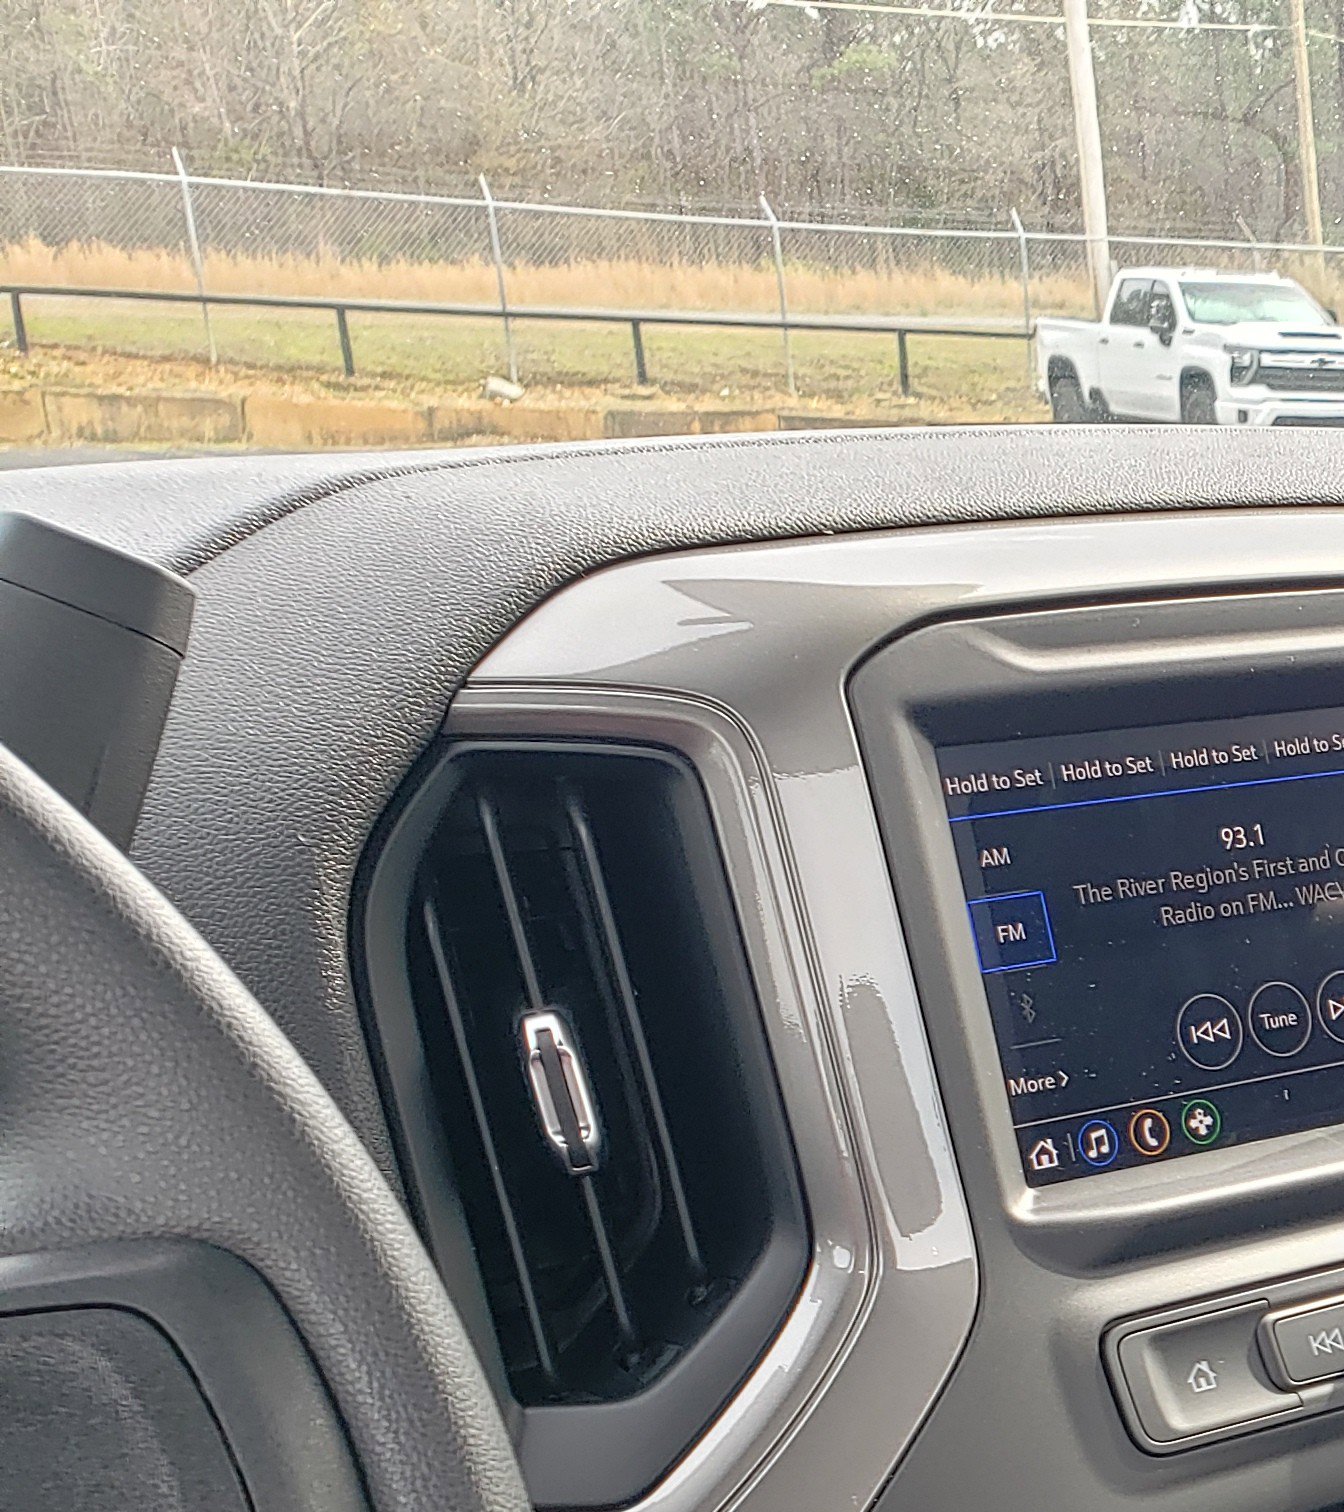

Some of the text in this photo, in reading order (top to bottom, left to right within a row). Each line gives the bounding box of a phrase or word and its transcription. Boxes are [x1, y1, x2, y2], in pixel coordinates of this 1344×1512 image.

[1171, 745, 1259, 769] Hold to Set
[1274, 738, 1310, 758] Hold
[1313, 737, 1329, 753] to
[1062, 756, 1154, 782] Hold to Set
[946, 769, 1044, 796] Hold to Set
[1221, 823, 1265, 850] 93.1
[981, 848, 1011, 868] AM
[1073, 884, 1113, 905] The
[1117, 876, 1165, 899] River
[1169, 862, 1249, 893] Region's
[1252, 857, 1293, 879] First
[1299, 850, 1330, 873] and
[1161, 903, 1214, 926] Radio
[1220, 900, 1244, 917] on
[1247, 891, 1294, 914] FM...
[997, 923, 1027, 943] FM
[1259, 1012, 1298, 1030] Tune
[1009, 1074, 1056, 1096] More
